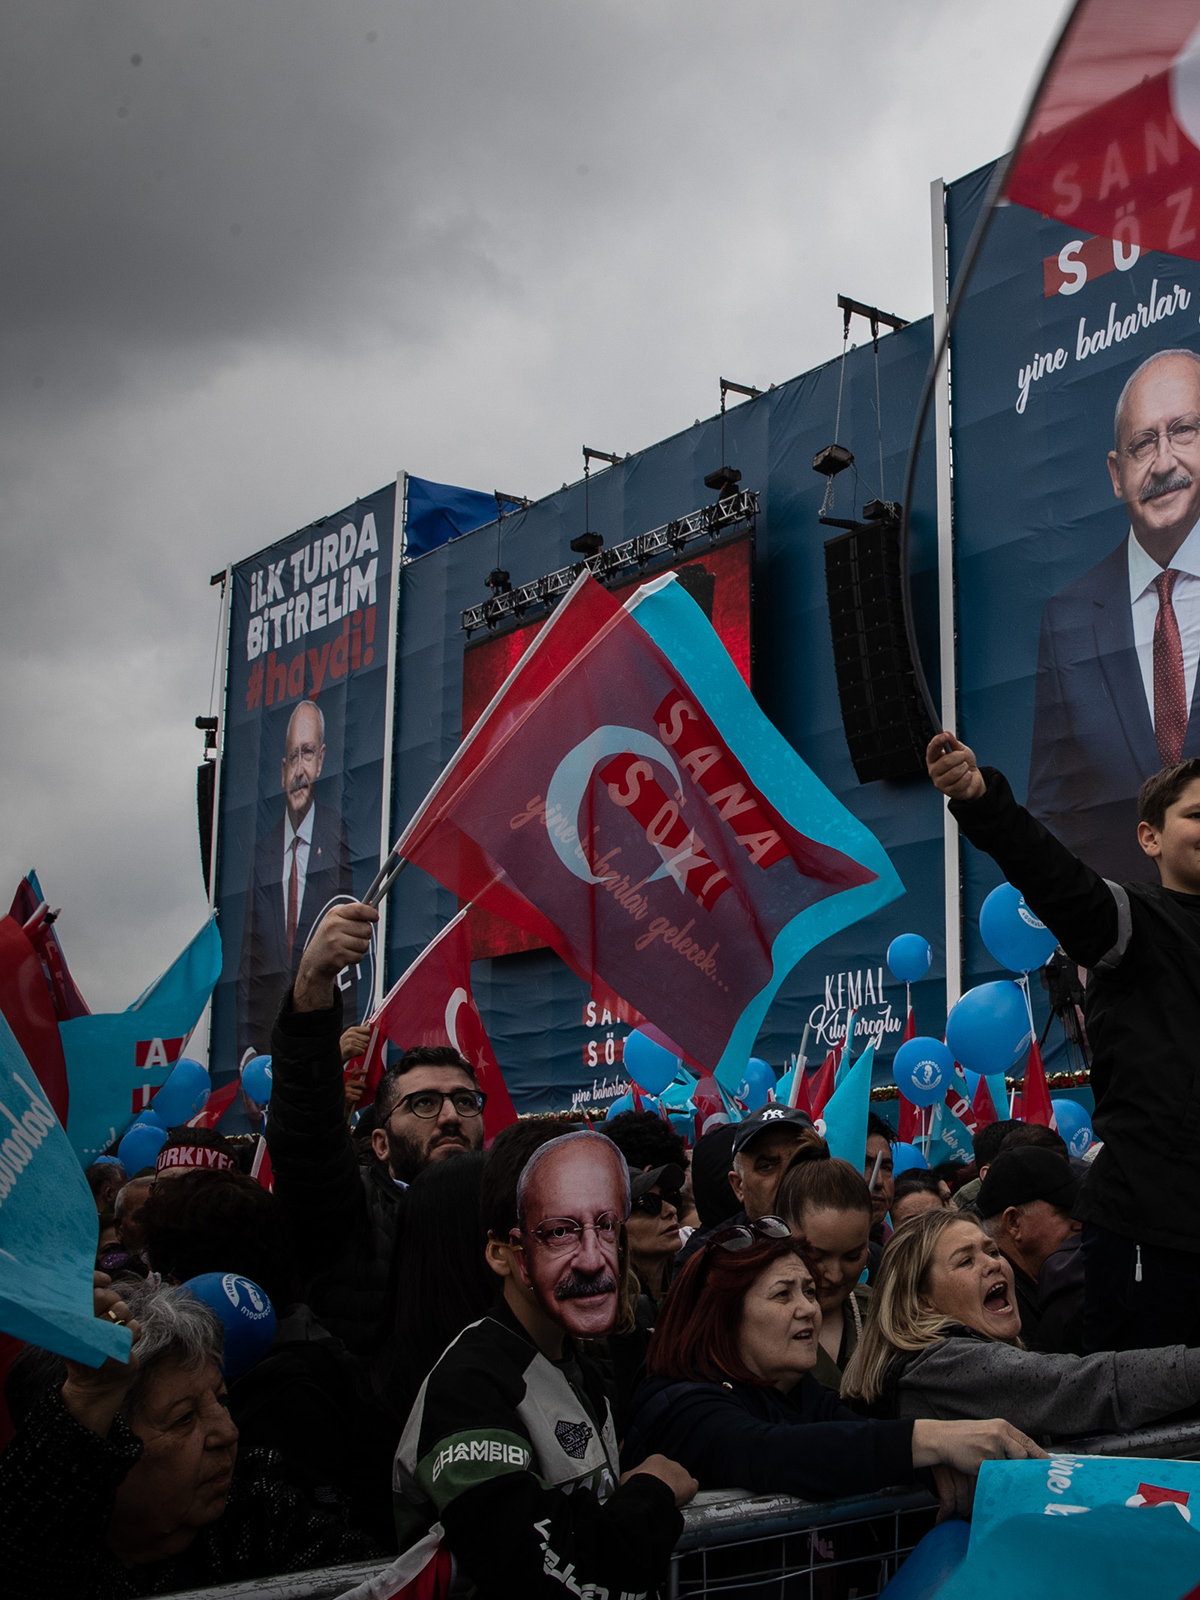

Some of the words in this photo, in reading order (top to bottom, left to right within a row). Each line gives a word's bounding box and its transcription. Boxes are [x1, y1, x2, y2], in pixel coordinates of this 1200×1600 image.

[1052, 105, 1200, 217] SAN
[1016, 344, 1068, 414] yine
[1076, 280, 1191, 361] baharlar
[246, 557, 379, 661] BİTİRELİM
[250, 558, 286, 613] İLK
[290, 512, 379, 592] TURDA
[246, 606, 377, 711] #haydi!
[509, 794, 577, 844] yine
[659, 700, 781, 865] SANA
[586, 997, 637, 1028] SAN
[825, 967, 888, 1011] KEMAL
[571, 1089, 591, 1112] yine
[593, 1075, 629, 1100] baharlar
[587, 1032, 627, 1067] SÖ
